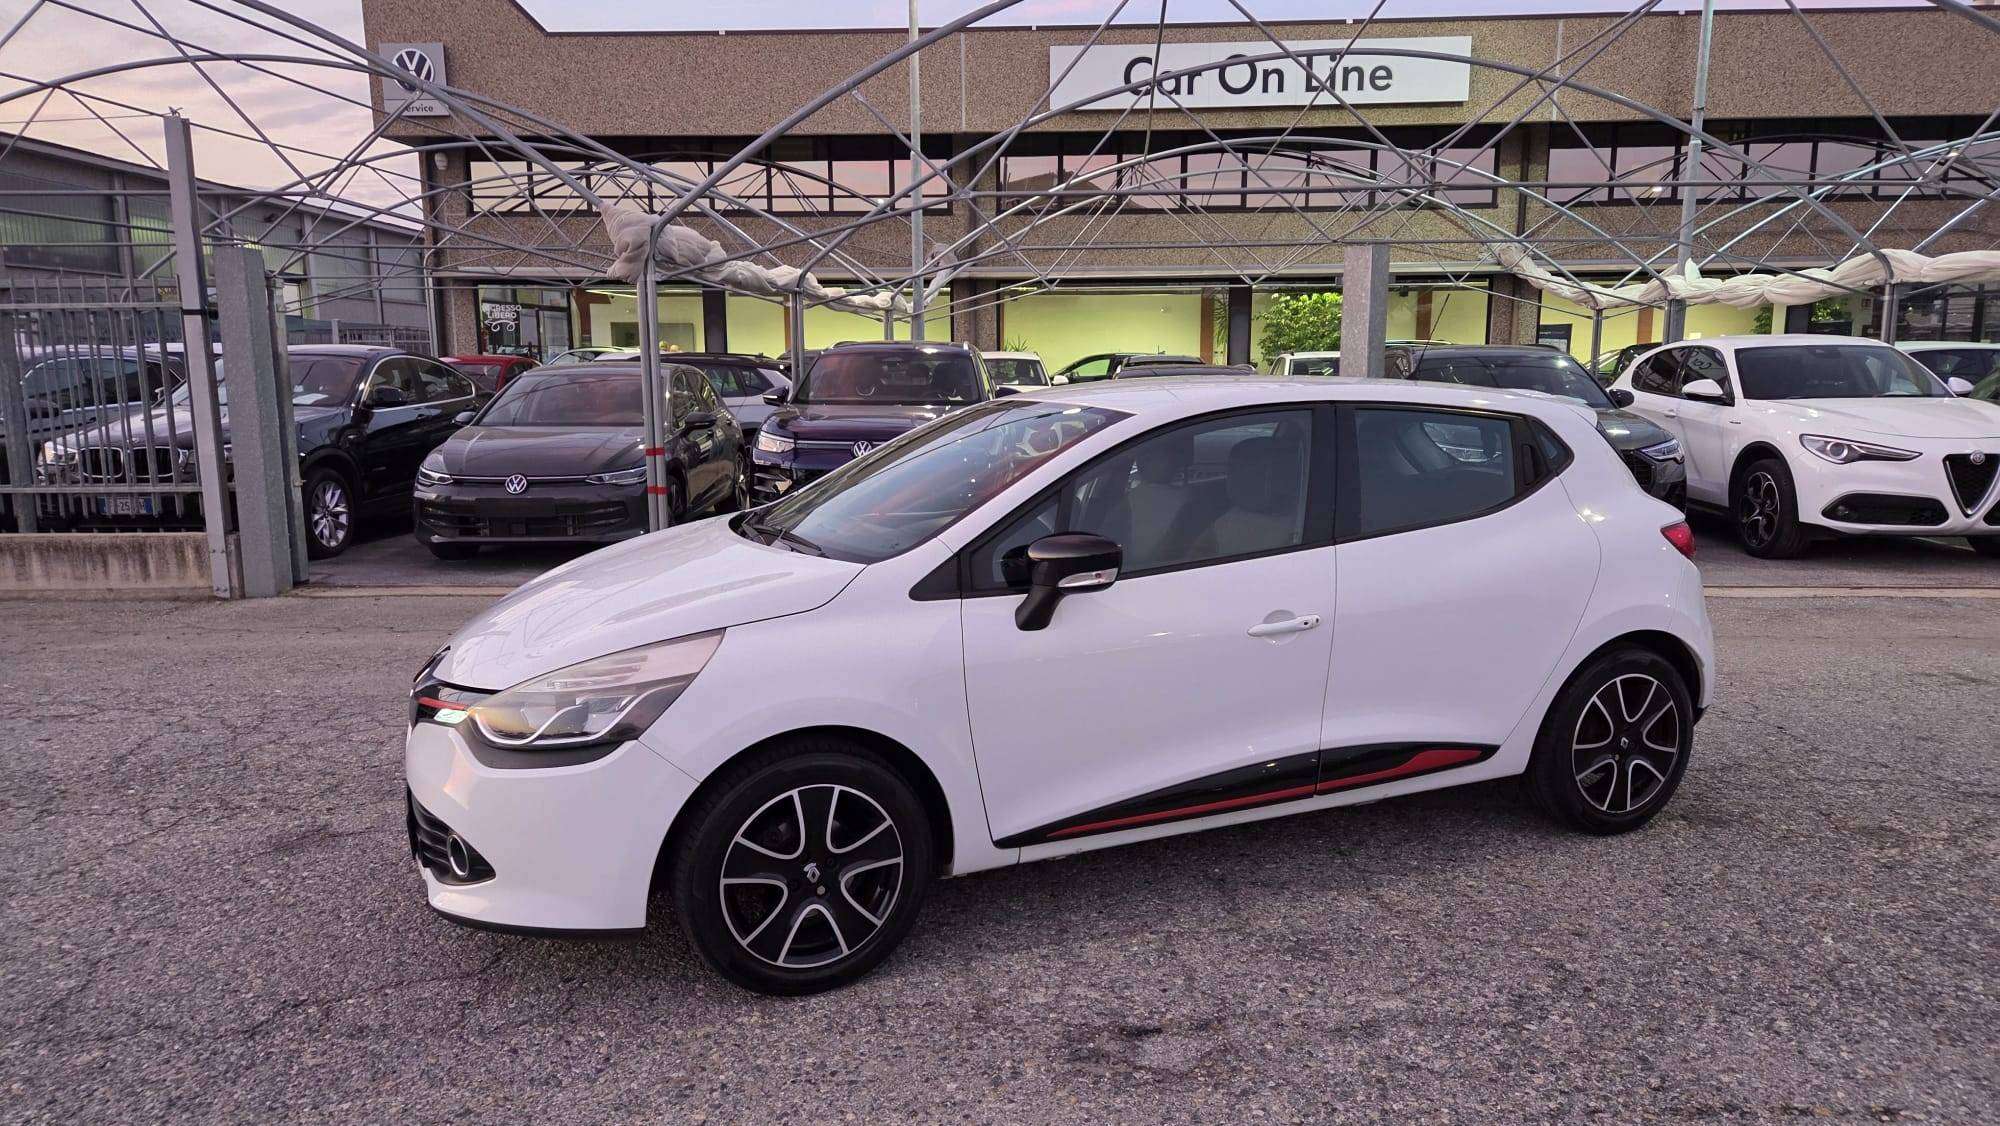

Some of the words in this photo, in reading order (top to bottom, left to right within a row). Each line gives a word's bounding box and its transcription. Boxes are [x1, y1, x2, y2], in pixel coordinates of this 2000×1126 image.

[1124, 56, 1200, 95] Car
[1218, 54, 1284, 94] On
[1305, 53, 1392, 92] Line
[402, 104, 433, 112] ervice
